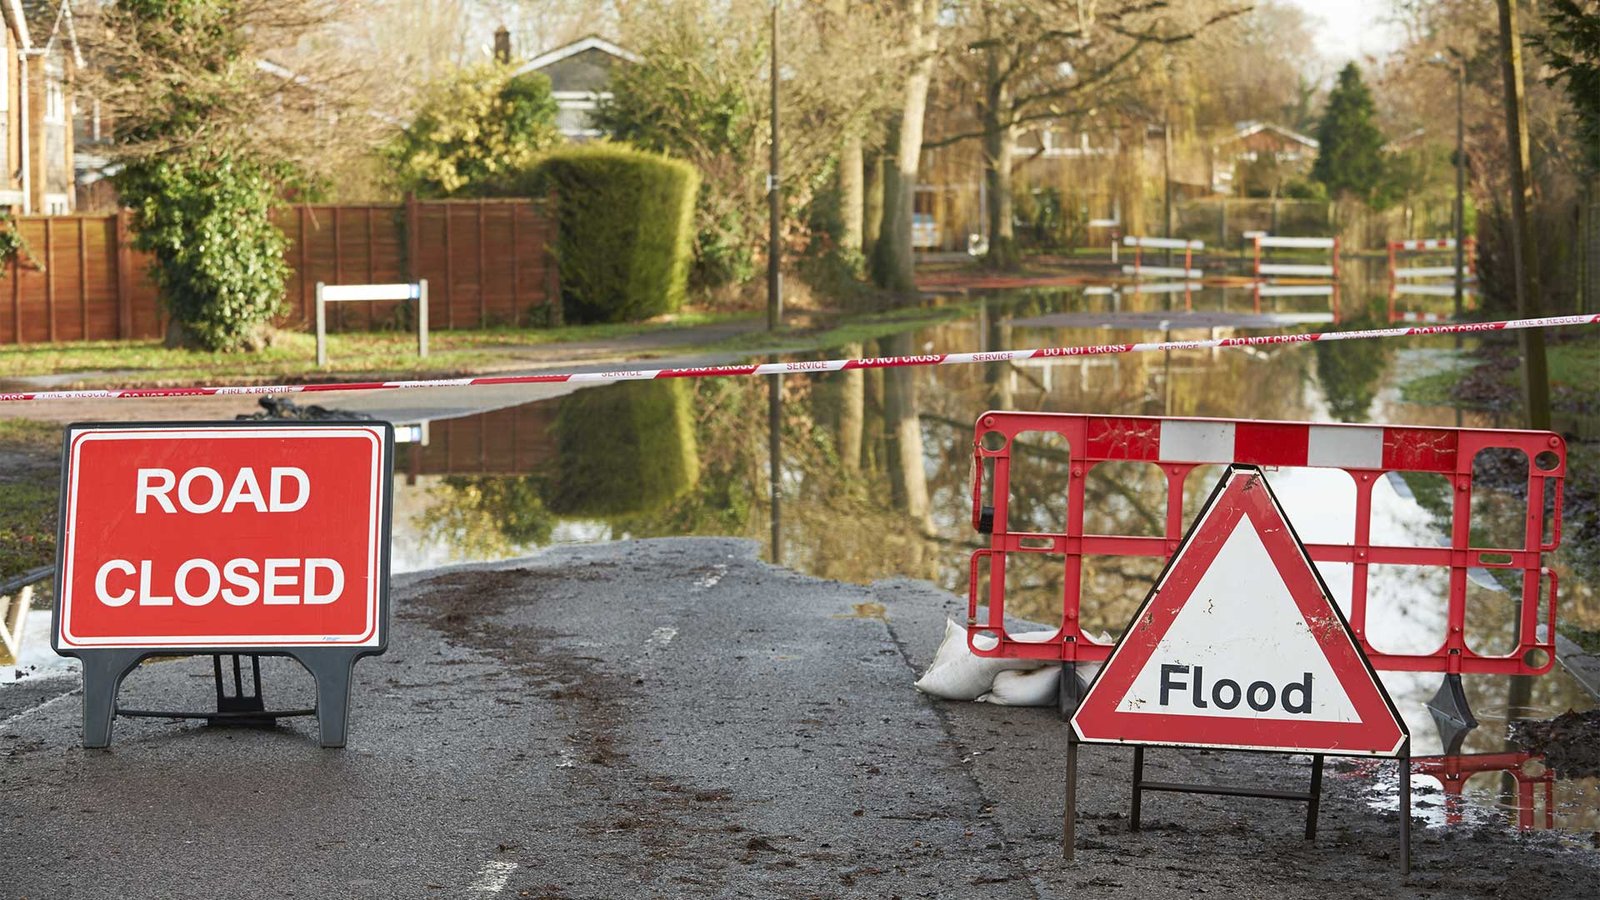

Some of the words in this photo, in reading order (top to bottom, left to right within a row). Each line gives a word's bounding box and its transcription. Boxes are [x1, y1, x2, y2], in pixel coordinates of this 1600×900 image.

[1229, 338, 1245, 346] DO
[1248, 336, 1270, 345] NOT
[1274, 334, 1312, 343] CROSS
[1043, 348, 1060, 356] DO
[1063, 346, 1084, 355] NOT
[1087, 344, 1126, 354] CROSS
[972, 352, 1014, 361] SERVICE
[786, 361, 828, 370] SERVICE
[135, 466, 311, 514] ROAD
[94, 557, 345, 607] CLOSED
[1159, 663, 1313, 714] Flood
